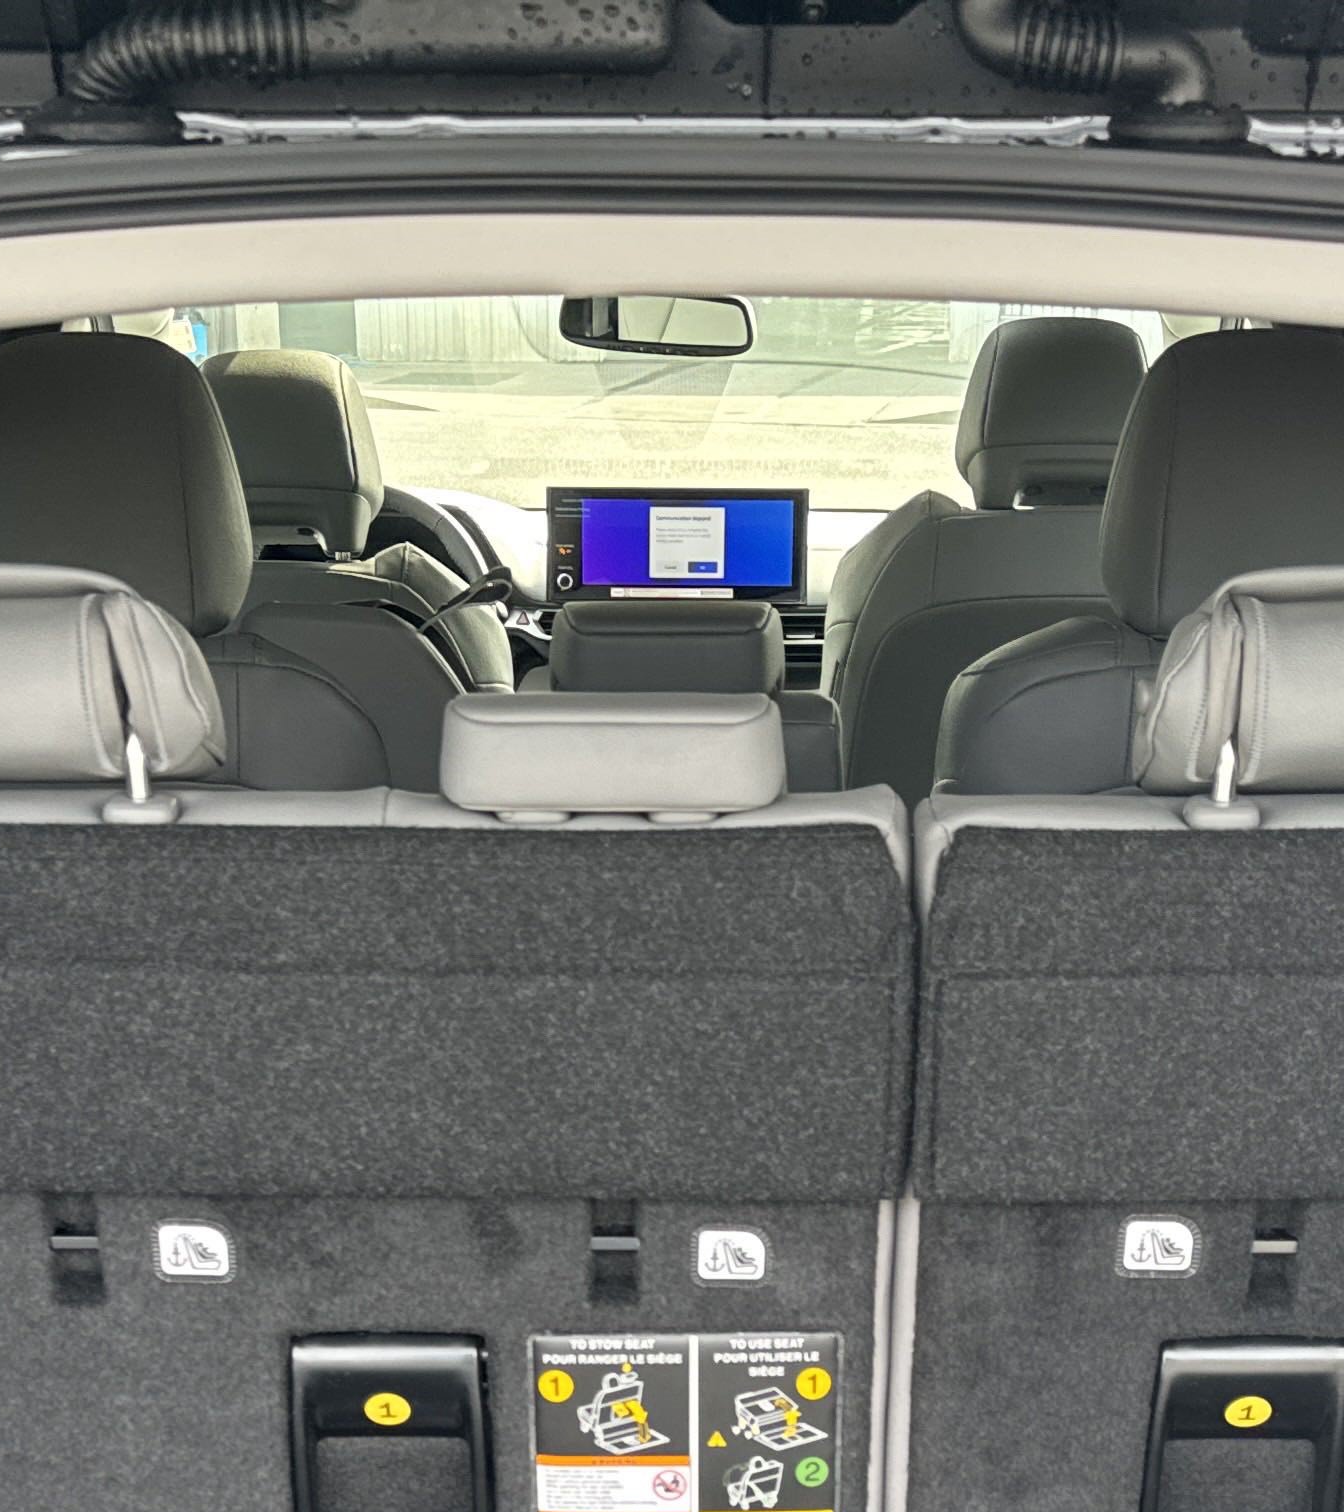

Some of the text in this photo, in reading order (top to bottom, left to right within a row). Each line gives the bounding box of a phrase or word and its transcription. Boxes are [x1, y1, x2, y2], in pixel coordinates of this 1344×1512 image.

[569, 1338, 656, 1350] TO STOW SEAT
[729, 1338, 805, 1350] TO USE SEAT
[542, 1353, 577, 1365] POUR
[578, 1353, 628, 1365] RANGER
[629, 1353, 645, 1365] LE
[713, 1350, 820, 1364] POUR UTILISER LE
[548, 1376, 559, 1396] 1
[807, 1373, 817, 1394] 1
[379, 1402, 397, 1419] 1
[1237, 1404, 1256, 1421] 1
[805, 1462, 819, 1482] 2
